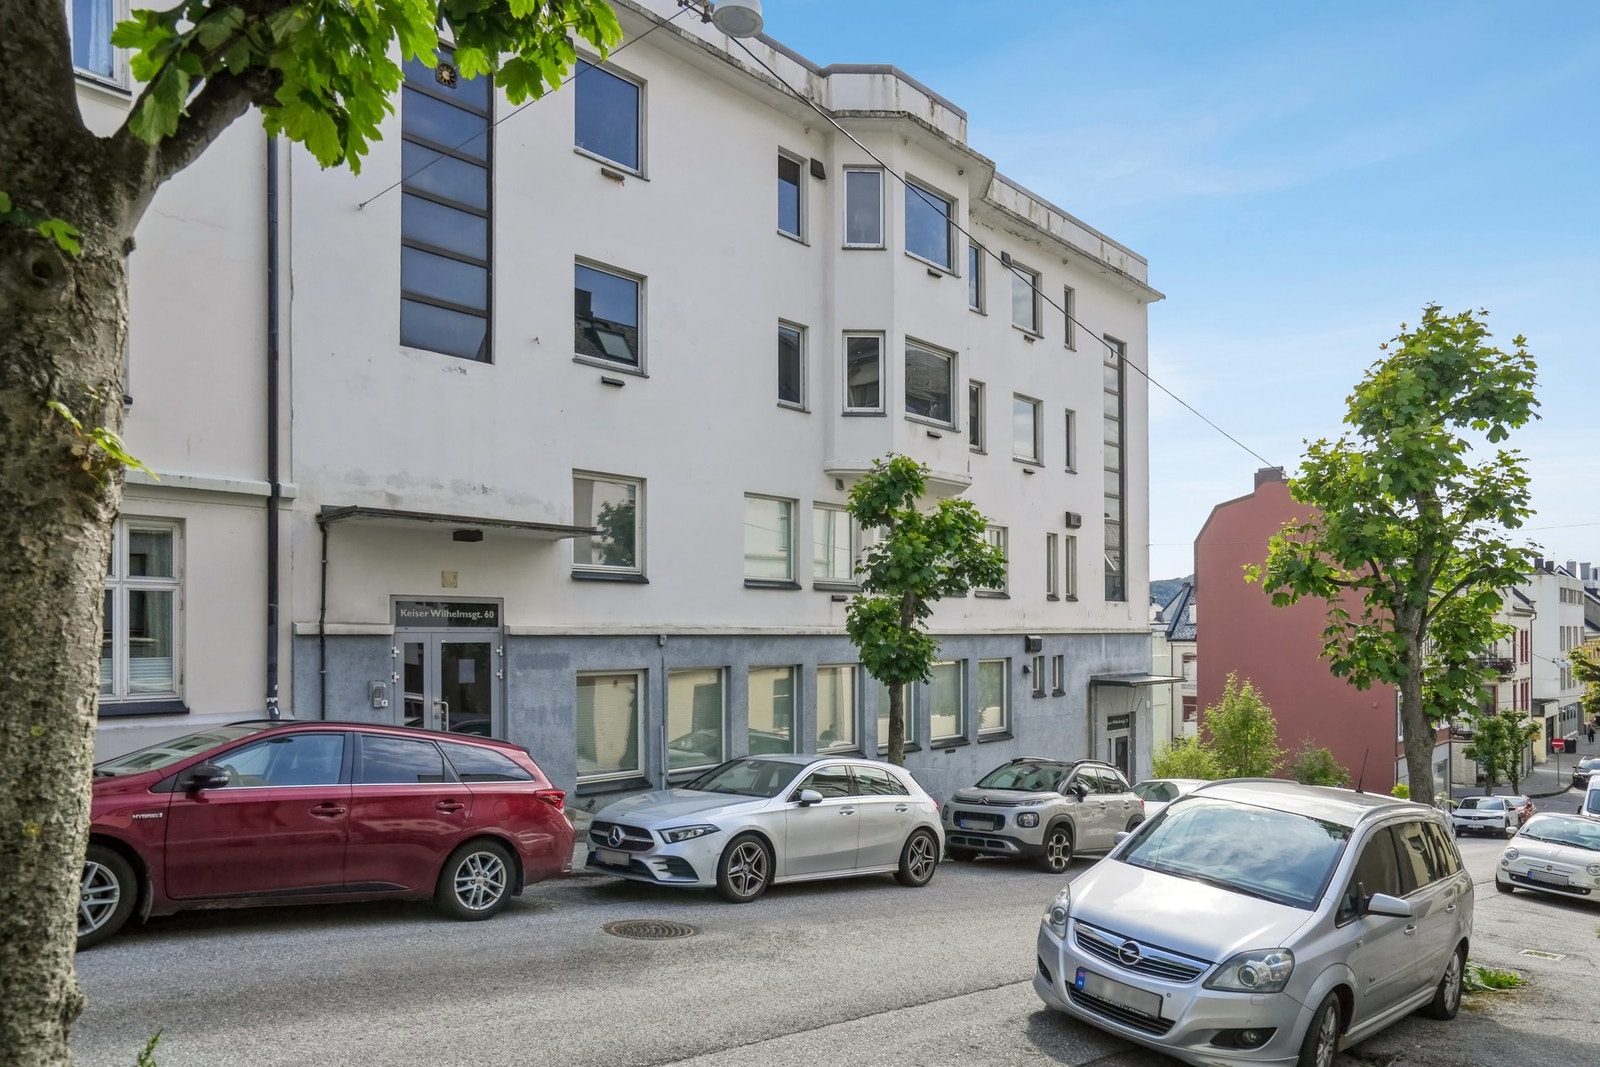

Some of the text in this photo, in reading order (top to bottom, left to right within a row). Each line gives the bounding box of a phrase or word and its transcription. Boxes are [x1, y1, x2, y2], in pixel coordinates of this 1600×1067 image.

[400, 609, 495, 620] Keiser Wilhelmsgt. 60
